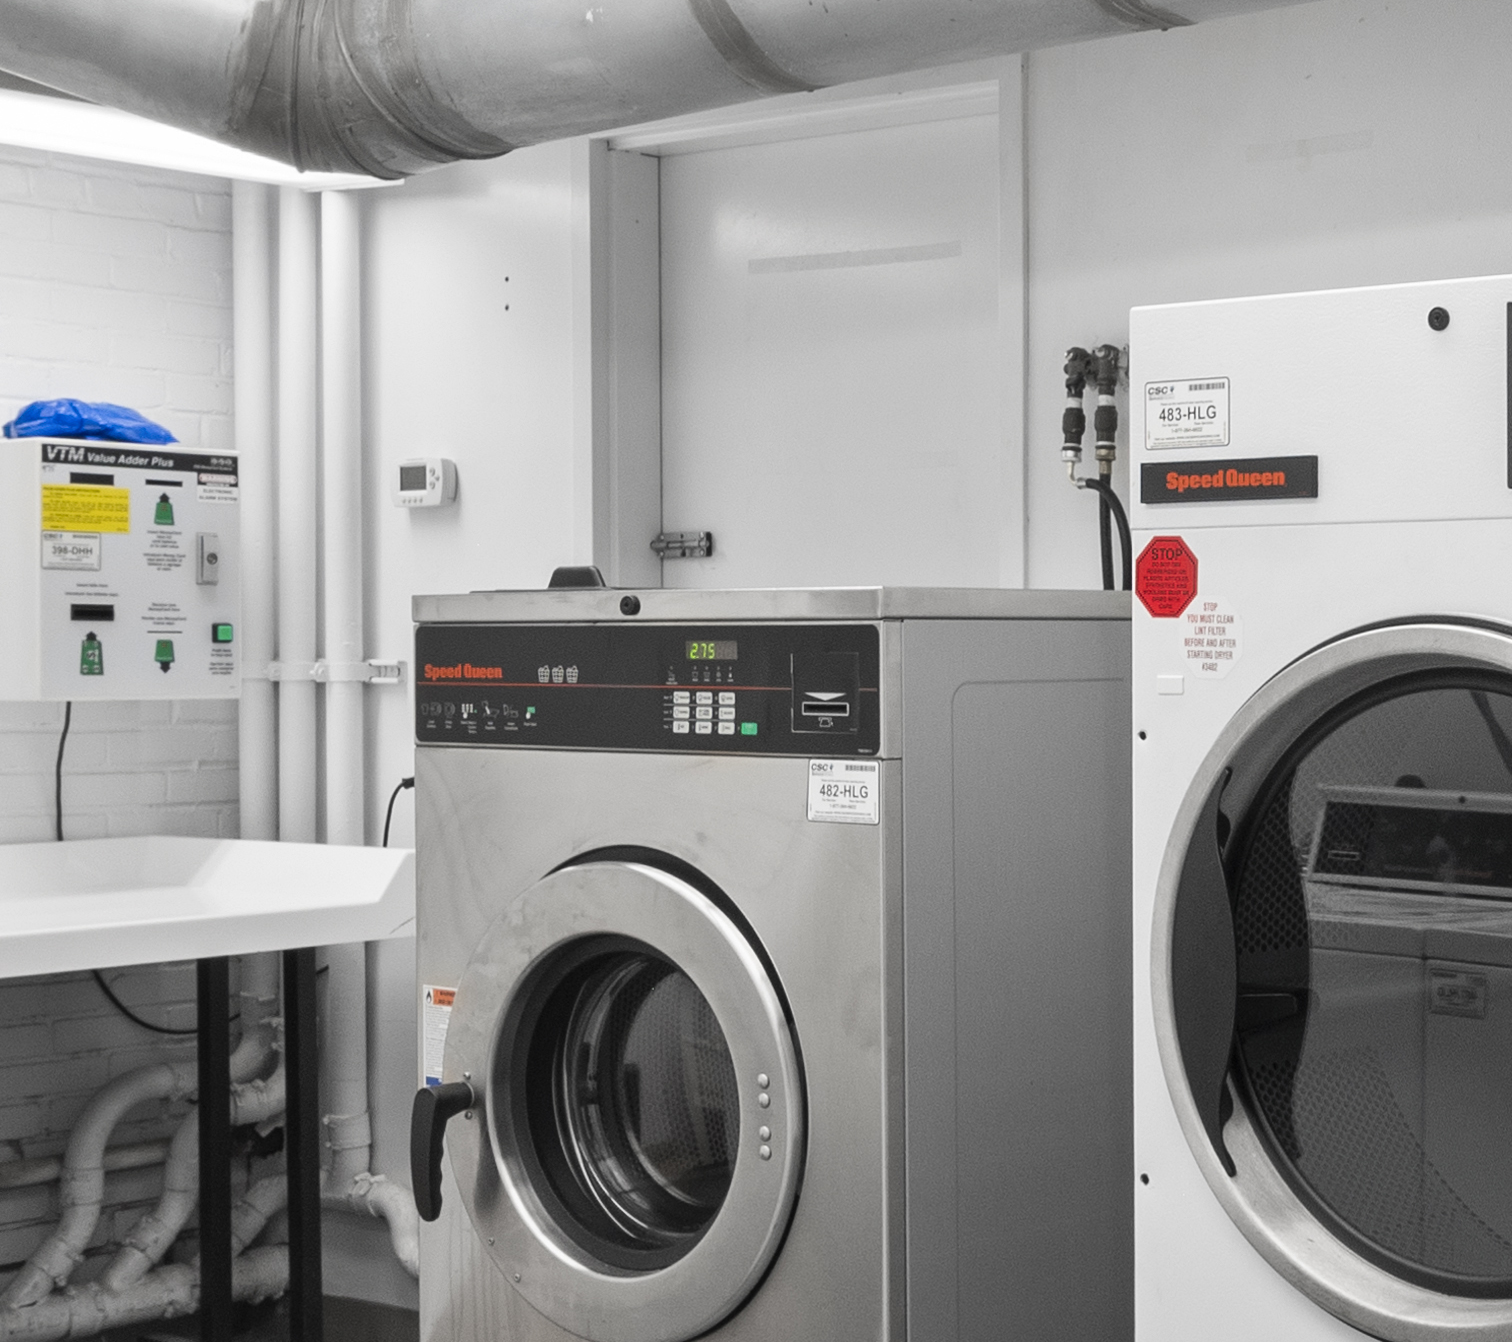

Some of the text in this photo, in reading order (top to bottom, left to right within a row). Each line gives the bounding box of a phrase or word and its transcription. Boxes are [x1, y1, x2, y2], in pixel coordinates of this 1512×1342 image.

[1148, 386, 1168, 395] CSC
[1159, 405, 1217, 422] 483-HLG
[47, 445, 174, 468] VTM Value Adder Plus
[1166, 469, 1285, 493] Speed Queen
[52, 545, 93, 555] 398-DHH
[1152, 548, 1183, 560] STOP
[1203, 603, 1218, 611] STOP
[1187, 615, 1234, 624] YOU MUST CLEAN
[1194, 627, 1226, 635] LINT FILTER
[1184, 638, 1236, 647] BEFORE AND AFTER
[1187, 650, 1233, 659] STARTING DRYER
[424, 663, 503, 681] Speed Queen
[820, 784, 868, 798] 482-HLG
